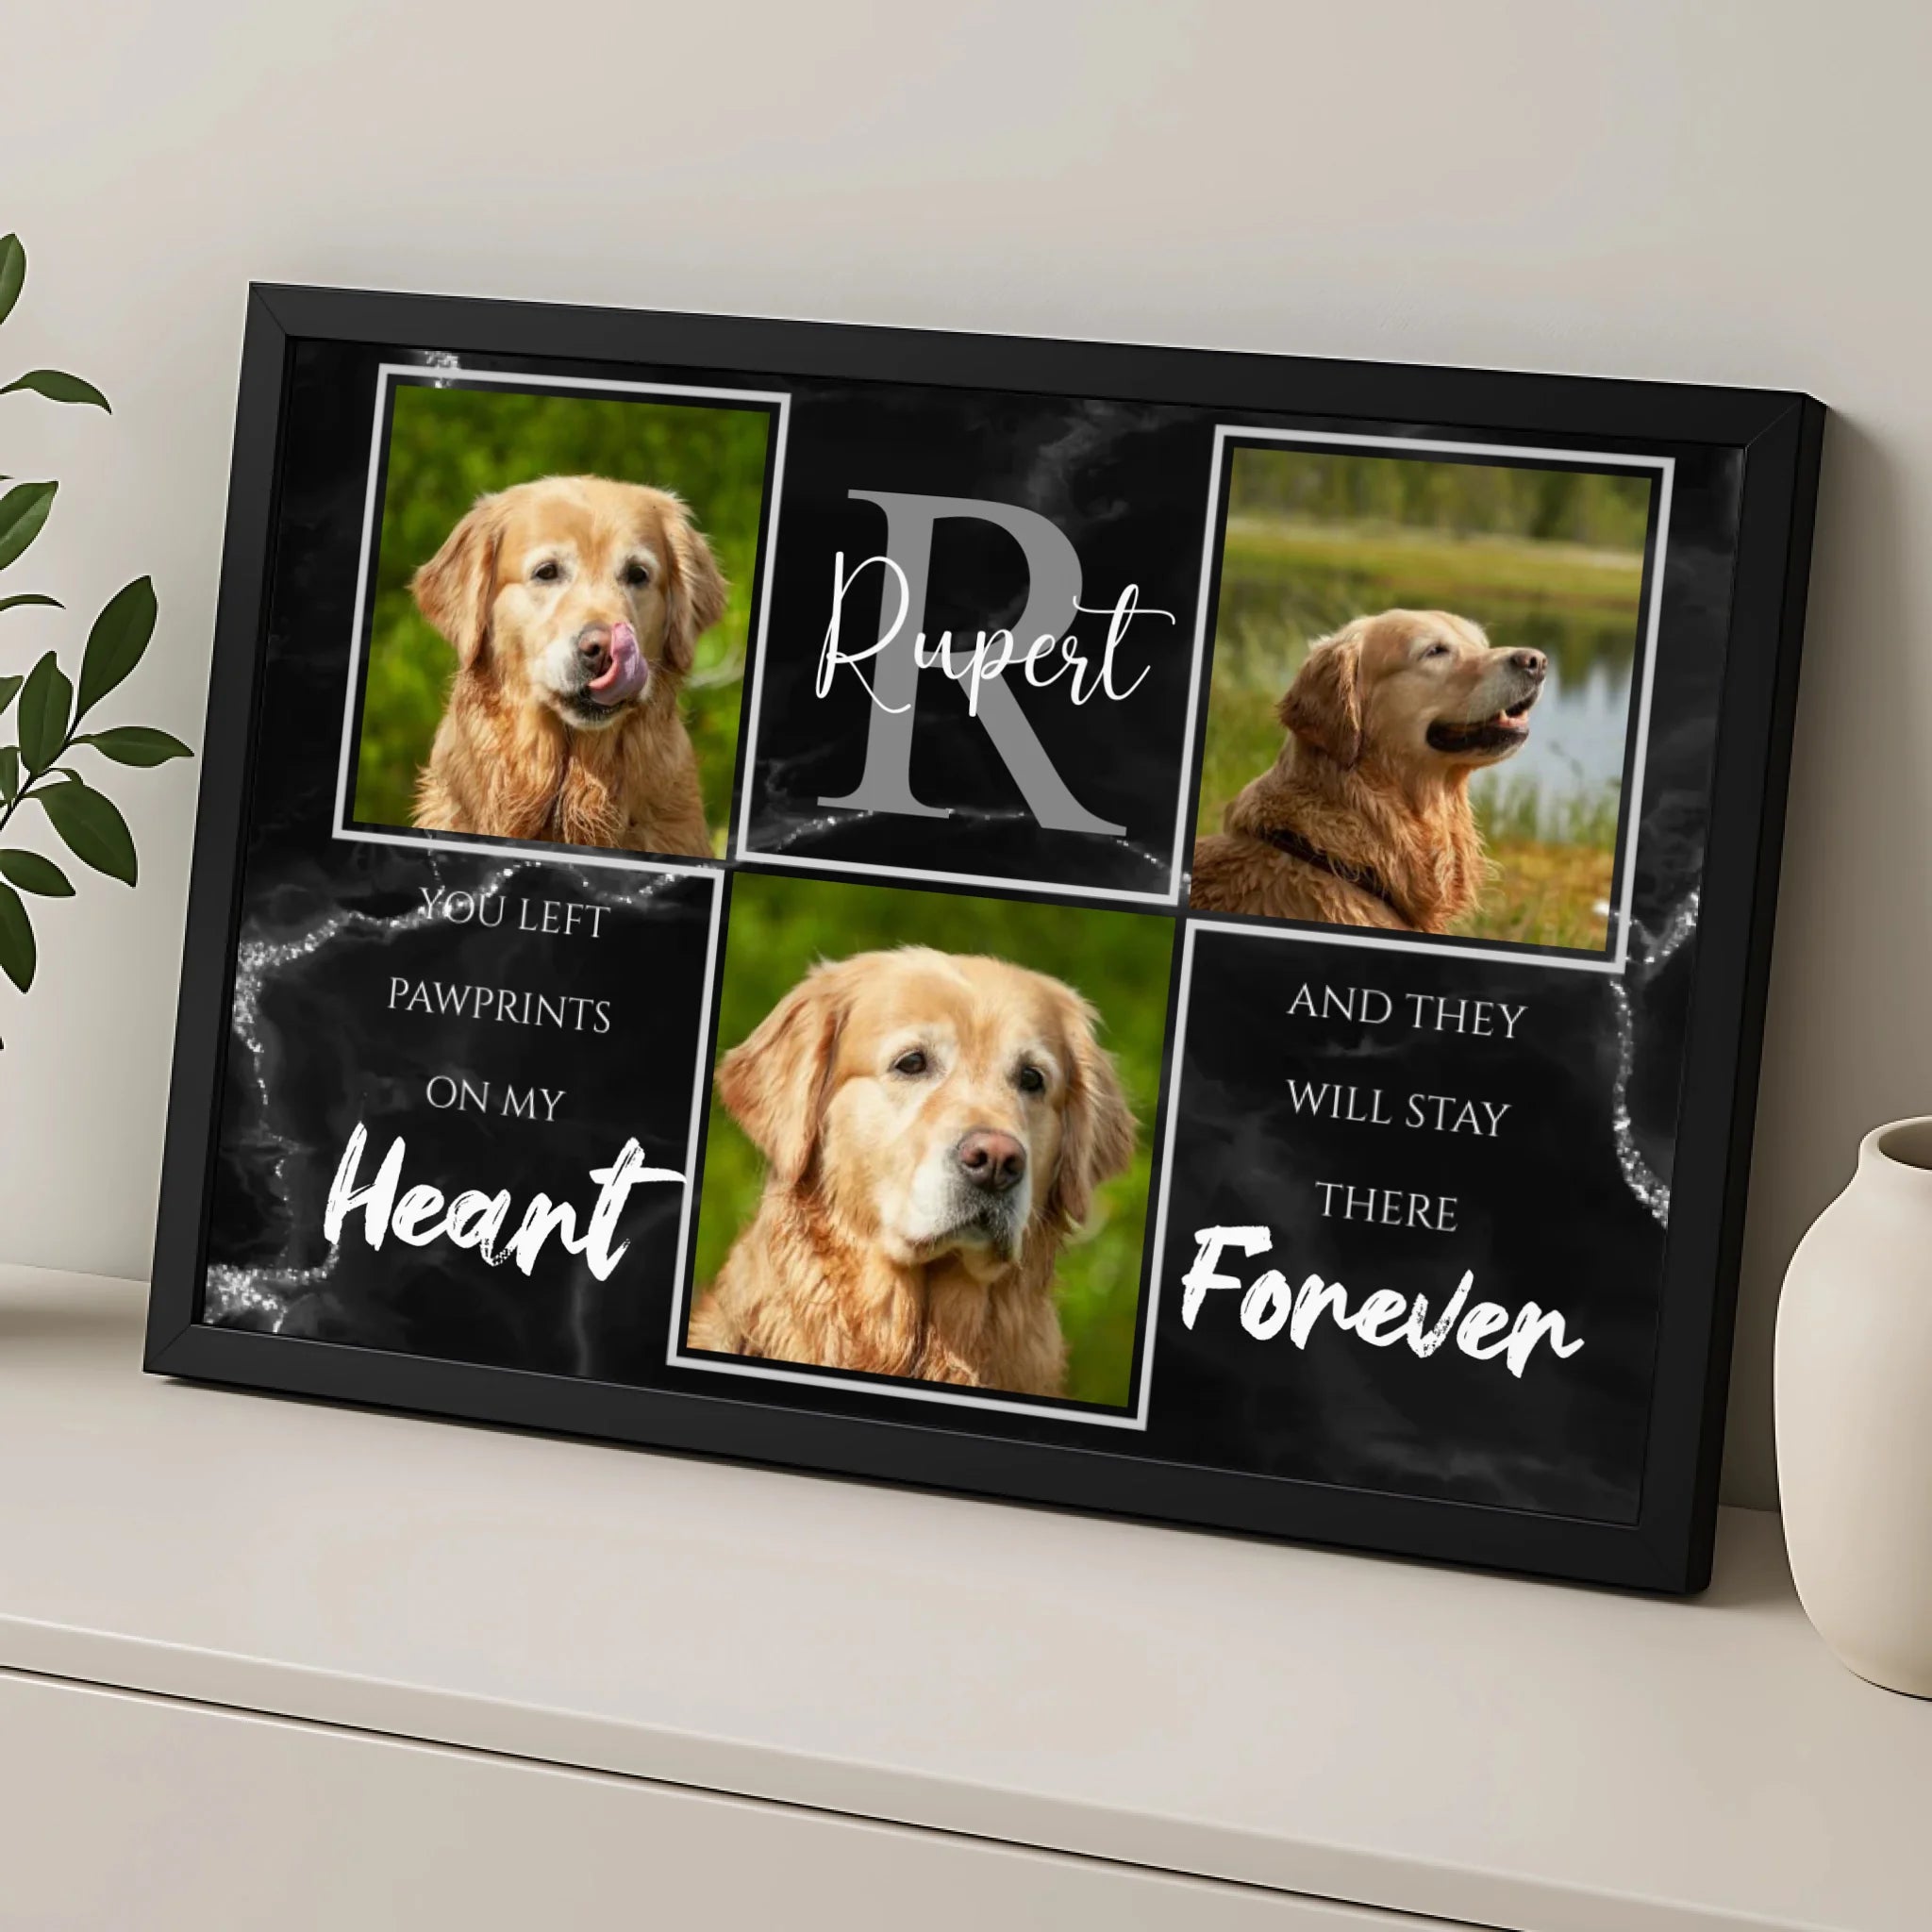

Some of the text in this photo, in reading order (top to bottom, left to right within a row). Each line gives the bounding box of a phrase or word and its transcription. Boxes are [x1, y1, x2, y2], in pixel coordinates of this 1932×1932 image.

[815, 551, 1176, 717] Rupert
[817, 489, 1126, 836] R
[420, 887, 611, 938] YOU LEFT
[388, 976, 611, 1034] PAWPRINTS
[1286, 983, 1528, 1039] AND THEY
[425, 1075, 566, 1123] ON MY
[1286, 1079, 1511, 1137] WILL STAY
[324, 1121, 687, 1281] Heart
[1315, 1181, 1458, 1232] THERE
[1181, 1225, 1585, 1378] Forever
